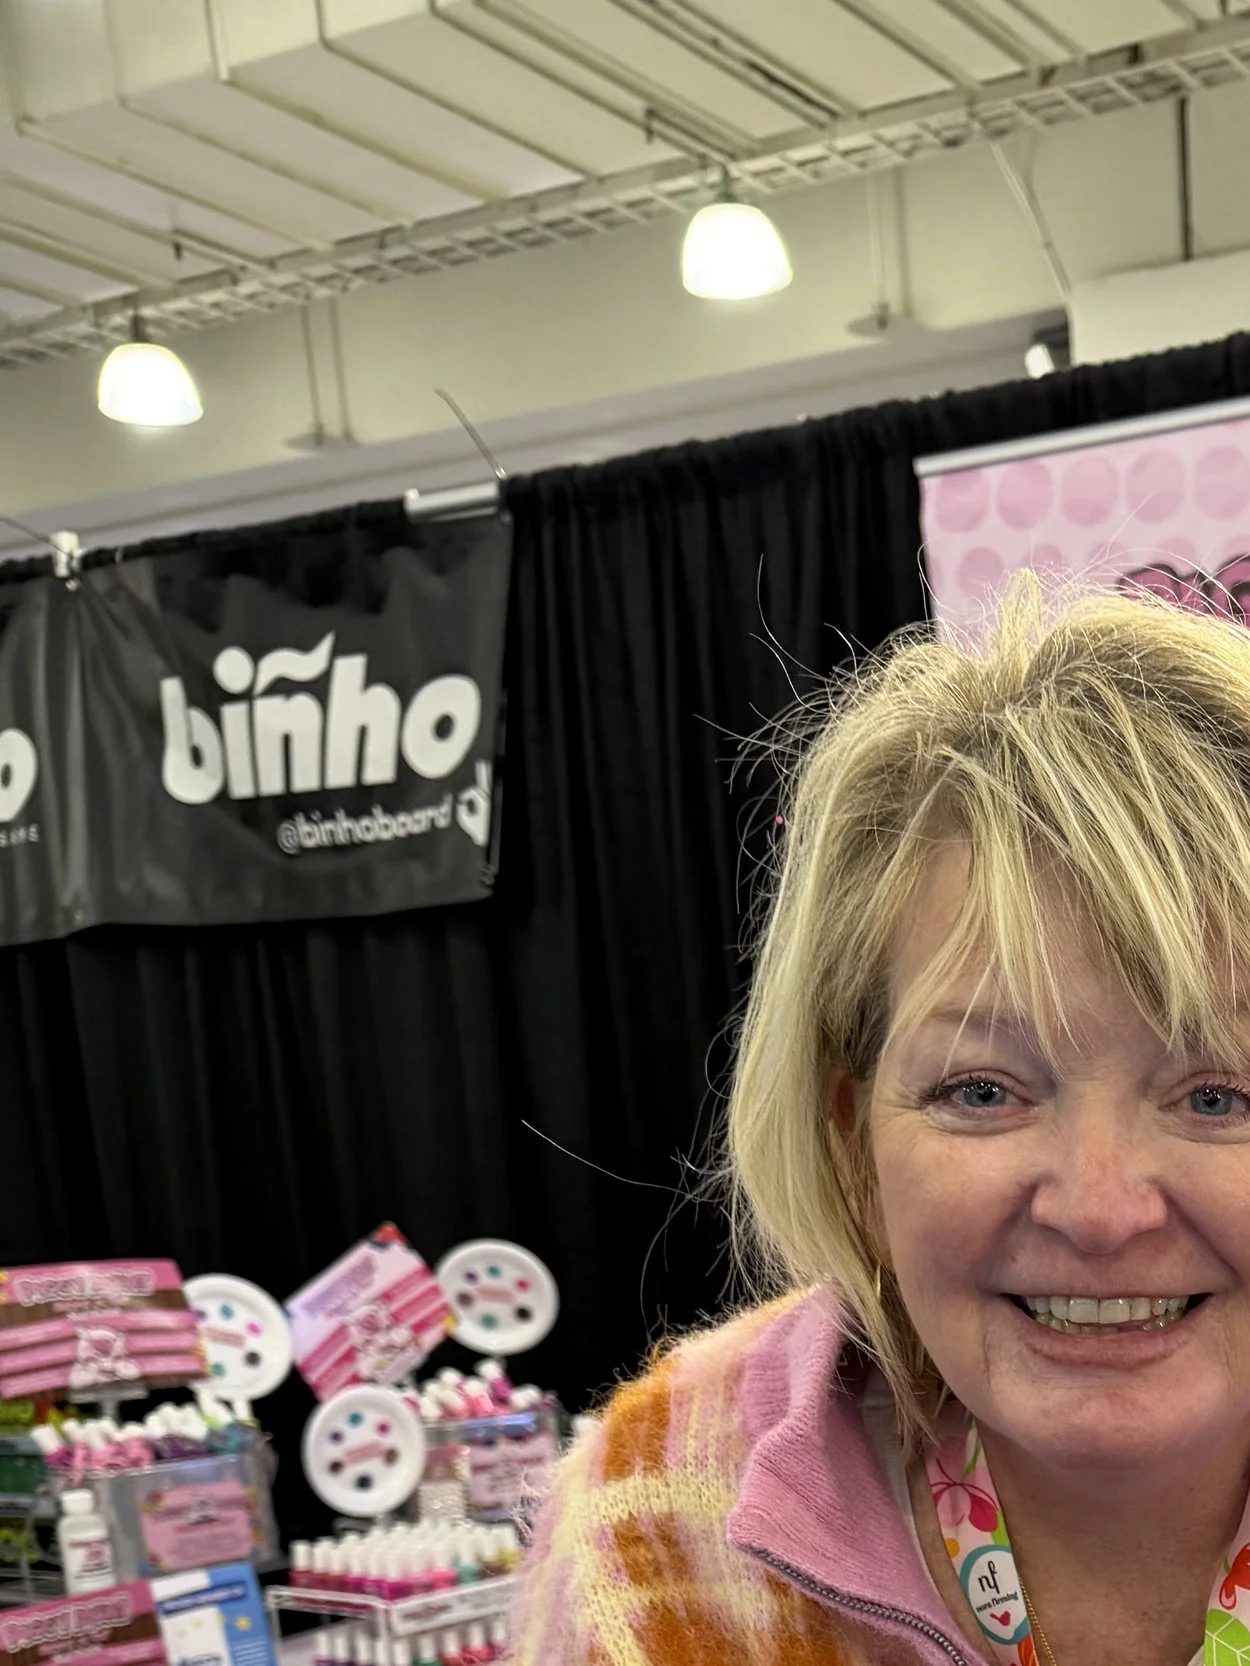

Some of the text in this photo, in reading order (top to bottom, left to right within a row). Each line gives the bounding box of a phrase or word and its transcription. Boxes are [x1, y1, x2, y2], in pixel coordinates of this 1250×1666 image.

[160, 630, 482, 804] biñho
[278, 795, 452, 854] @binhoboard
[977, 1560, 1001, 1595] nf
[975, 1591, 1019, 1613] nora fleming
